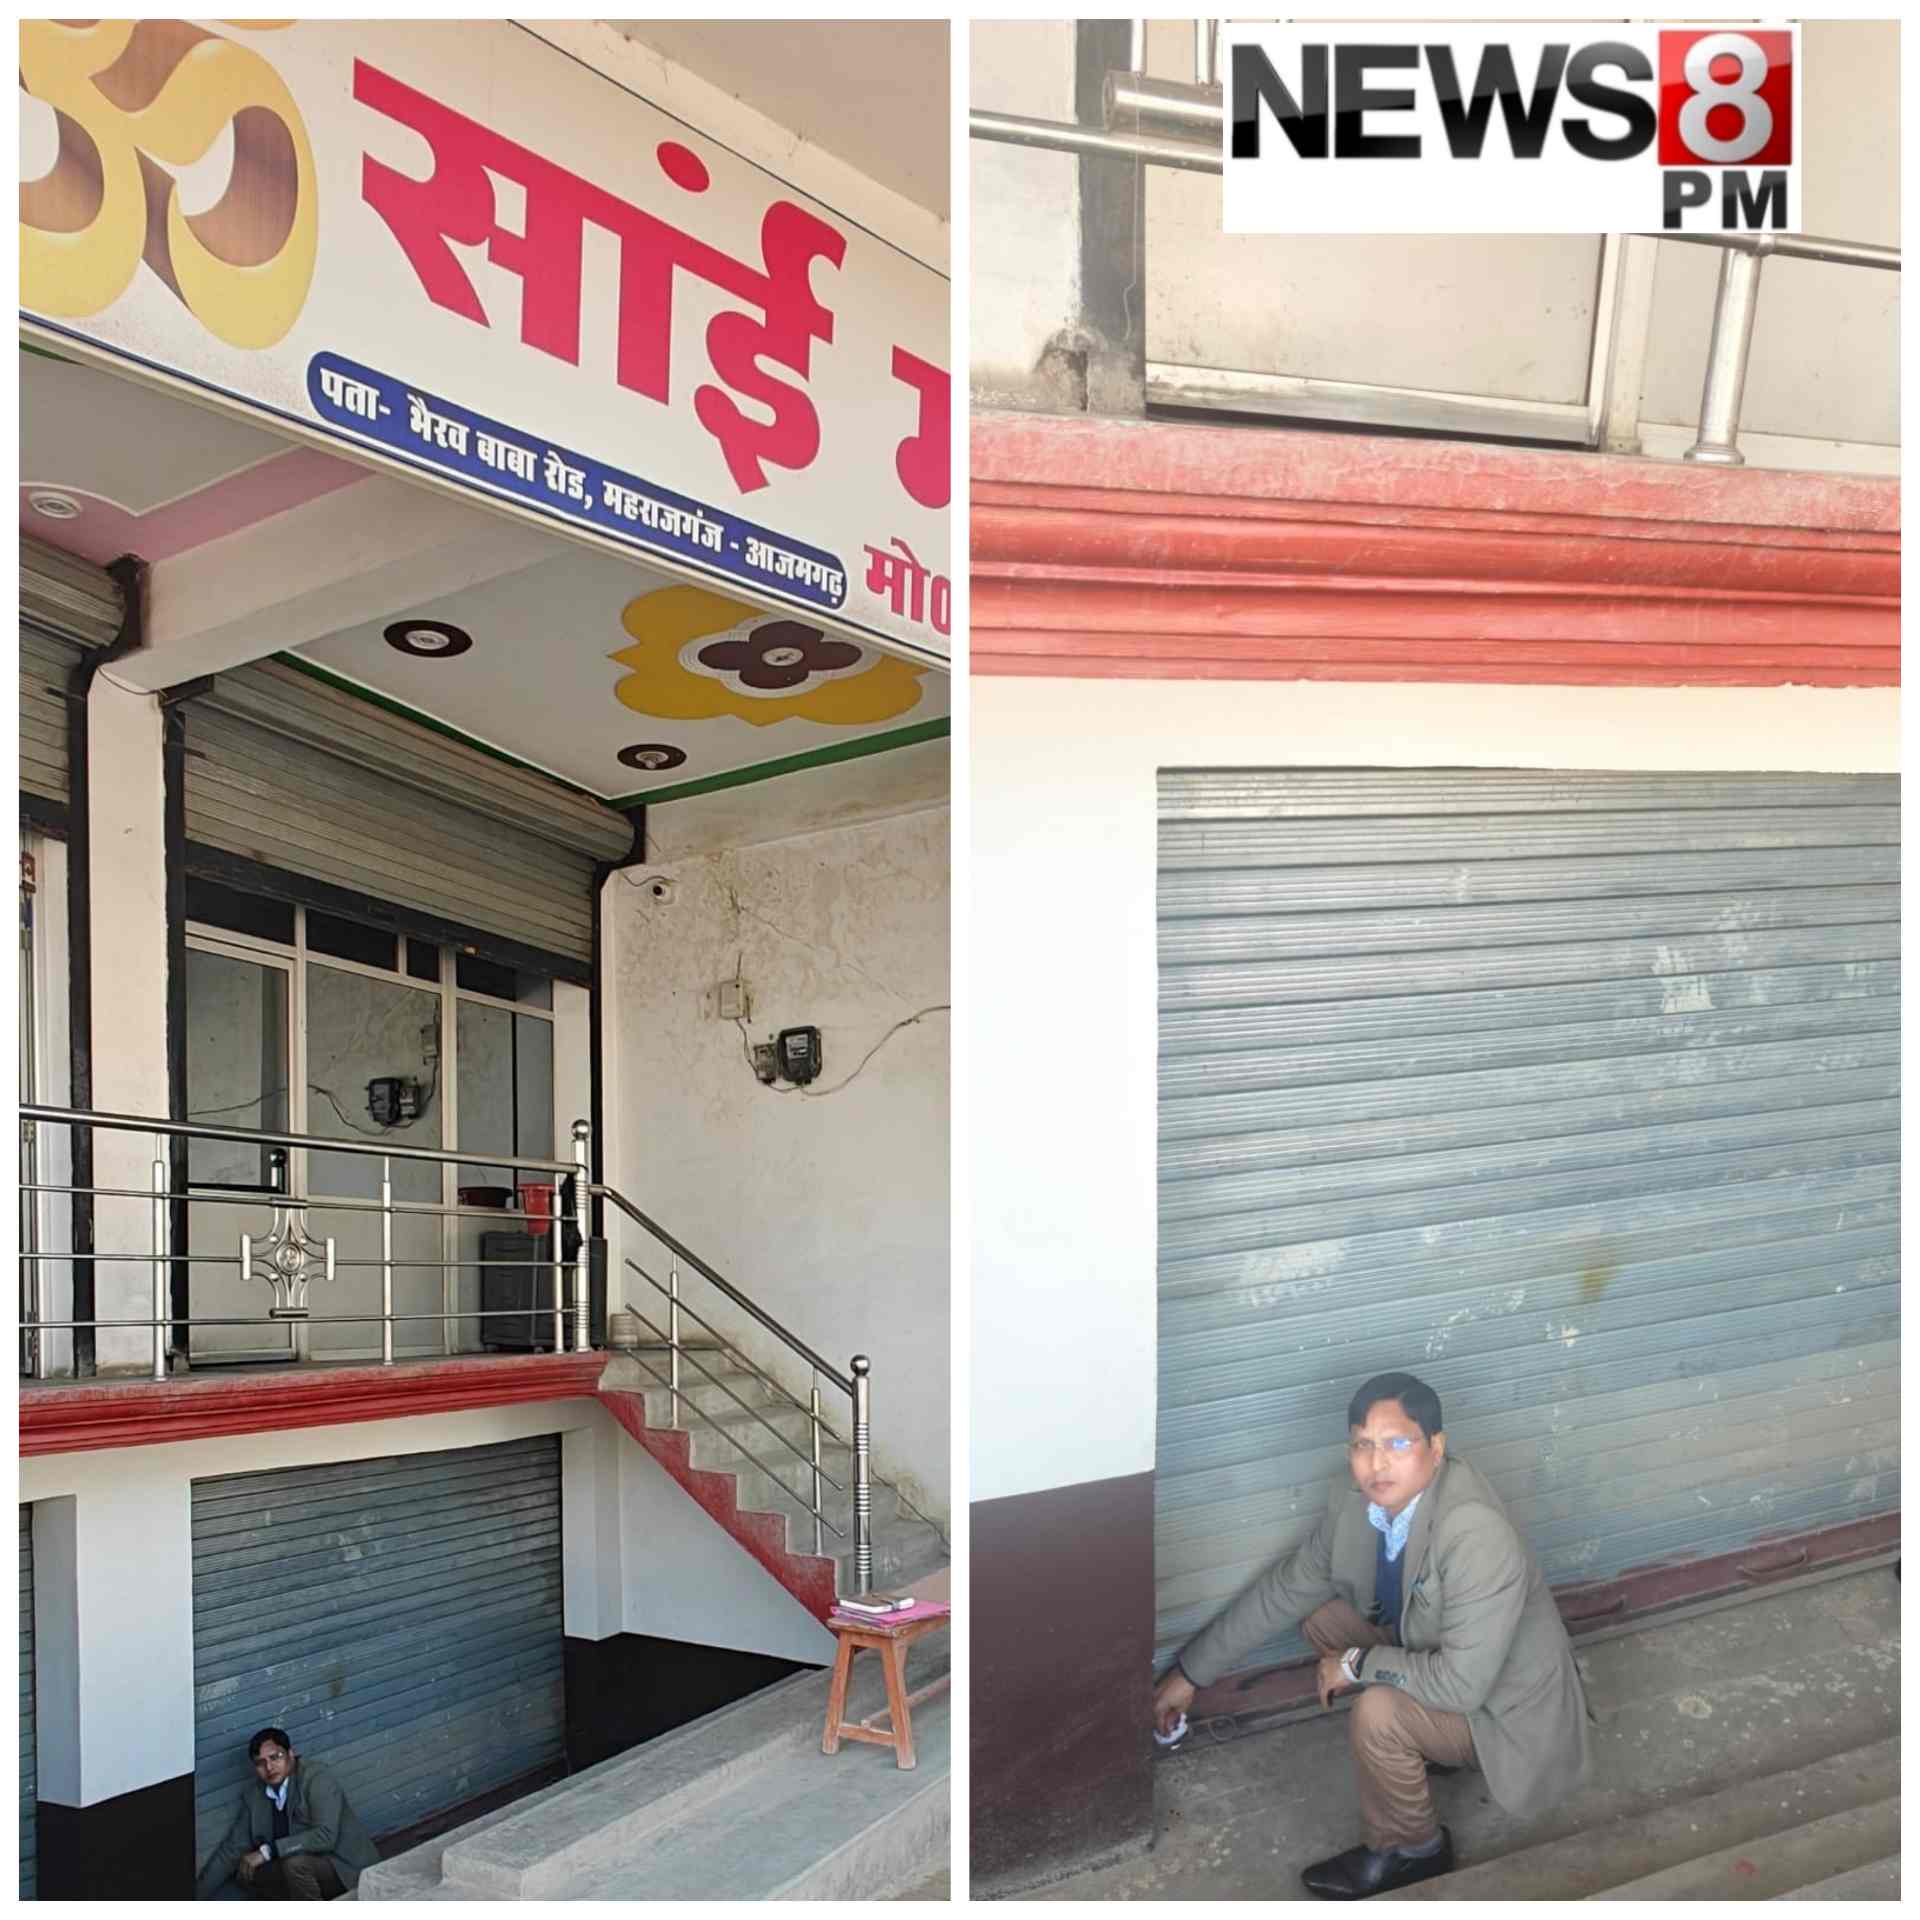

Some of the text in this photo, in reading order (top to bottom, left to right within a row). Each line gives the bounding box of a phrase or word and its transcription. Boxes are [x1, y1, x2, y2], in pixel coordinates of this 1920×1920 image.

[353, 57, 848, 494] सांई
[320, 367, 391, 420] पता-
[407, 393, 470, 456] भैरव
[475, 430, 538, 482] बाबा
[543, 450, 593, 509] रोड,
[602, 480, 724, 552] महराजगंज
[744, 536, 844, 603] आजमगढ़
